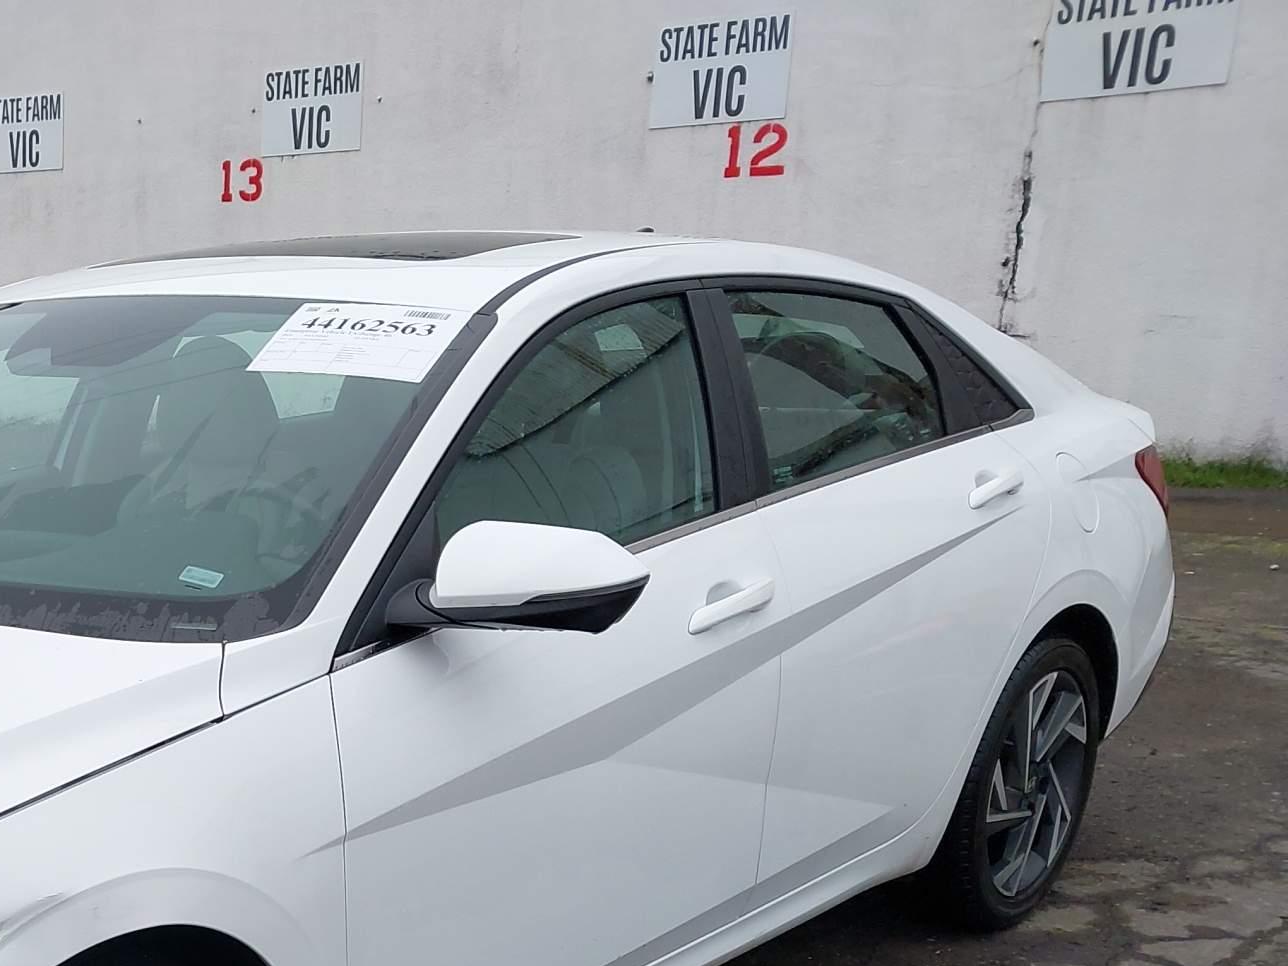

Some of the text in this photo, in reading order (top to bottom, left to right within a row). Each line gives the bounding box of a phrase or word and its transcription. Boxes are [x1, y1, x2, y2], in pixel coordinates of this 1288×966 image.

[659, 14, 791, 63] STATE FARM
[1102, 23, 1176, 90] VIC
[265, 62, 360, 102] STATE FARM
[693, 65, 747, 120] VIC
[25, 93, 62, 123] FARM
[291, 104, 331, 150] VIC
[8, 129, 40, 169] VIC
[723, 122, 789, 179] 12
[220, 157, 264, 203] 13
[302, 316, 437, 337] 44162563
